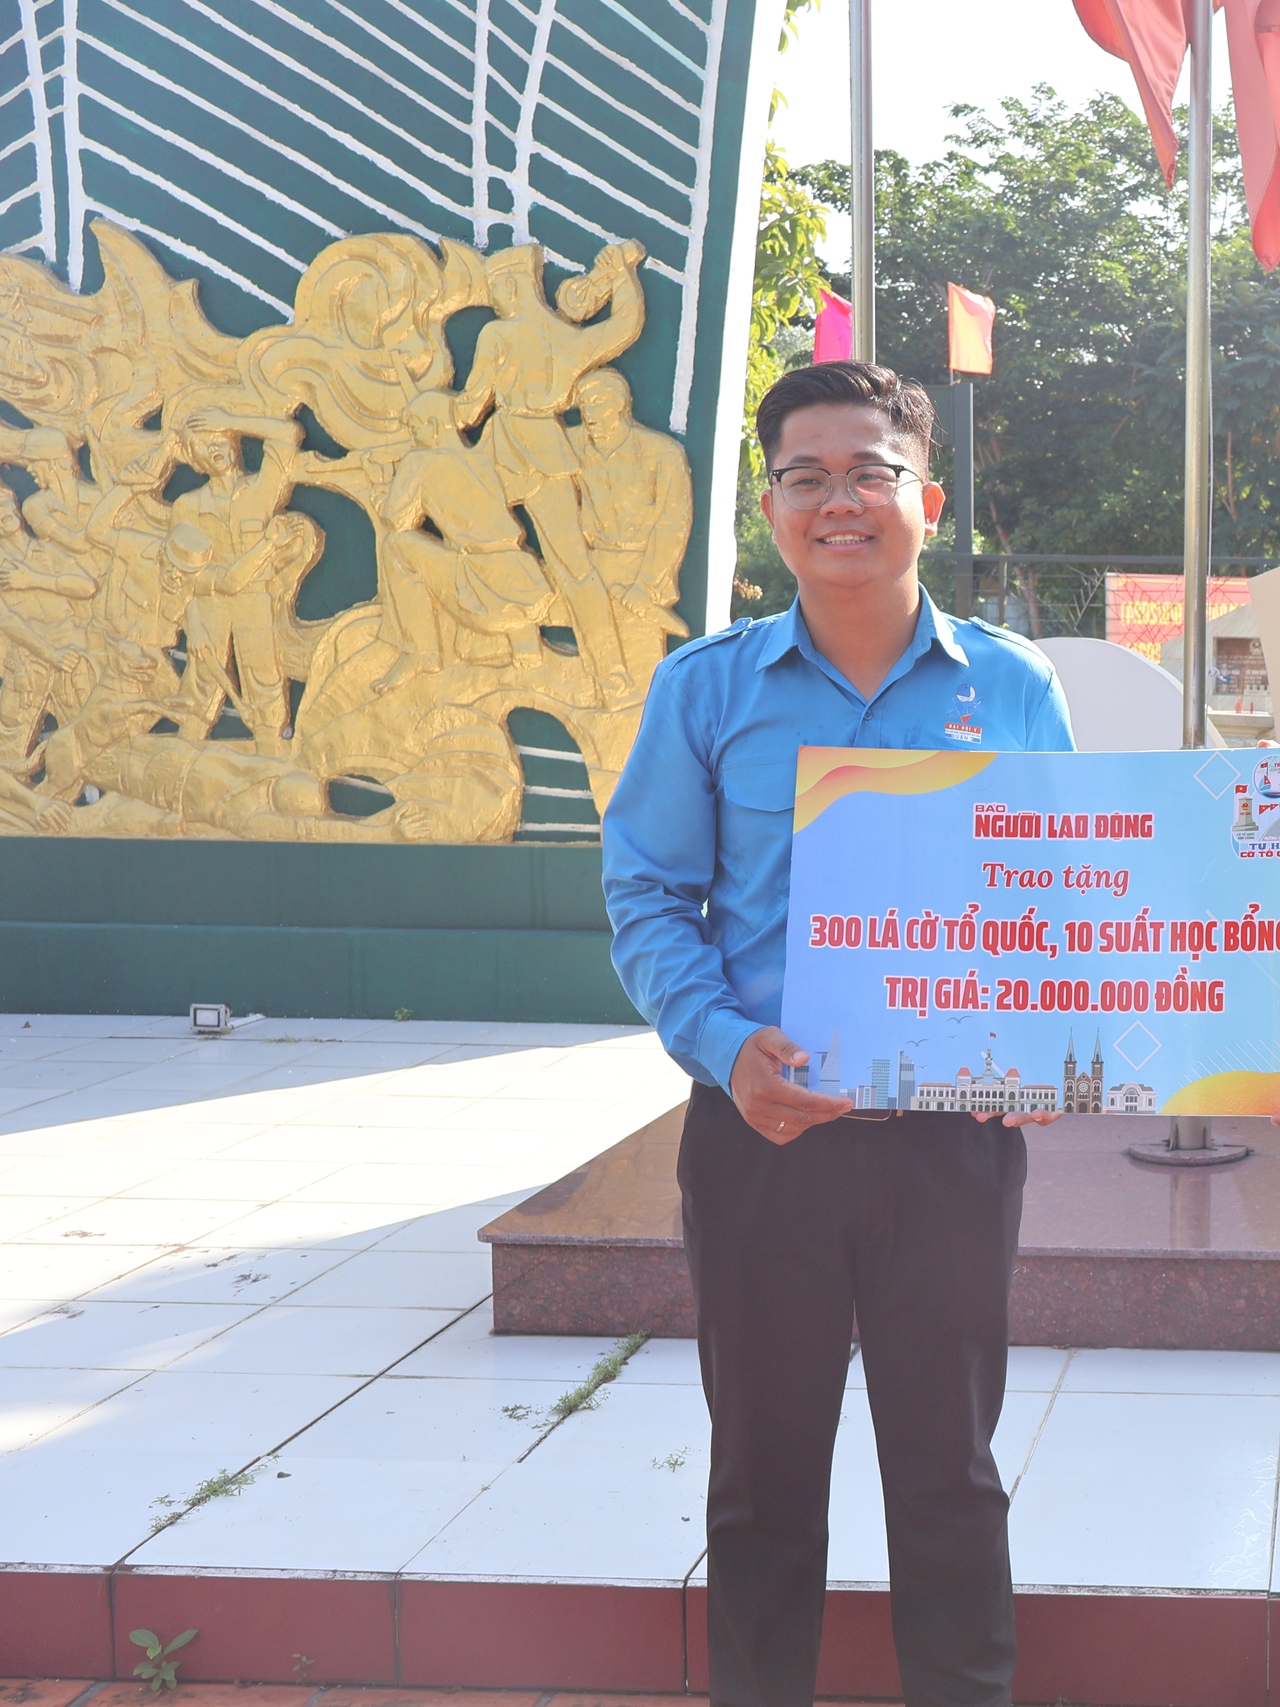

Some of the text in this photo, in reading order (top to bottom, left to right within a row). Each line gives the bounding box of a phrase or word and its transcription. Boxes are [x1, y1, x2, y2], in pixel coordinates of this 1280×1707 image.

[975, 804, 1006, 813] BÁO
[975, 812, 1153, 840] NGƯỜI LAO ĐỘNG
[983, 863, 1128, 896] Trao tặng
[811, 916, 861, 947] 300
[869, 910, 898, 948] LÁ
[906, 912, 939, 949] CỜ
[944, 904, 979, 950] TỔ
[982, 908, 1057, 958] QUỐC,
[1065, 922, 1092, 952] 10
[1100, 908, 1164, 952] SUẤT
[1171, 921, 1217, 960] HỌC
[886, 967, 1223, 1016] TRỊ GIÁ: 20.000.000 ĐỒNG
